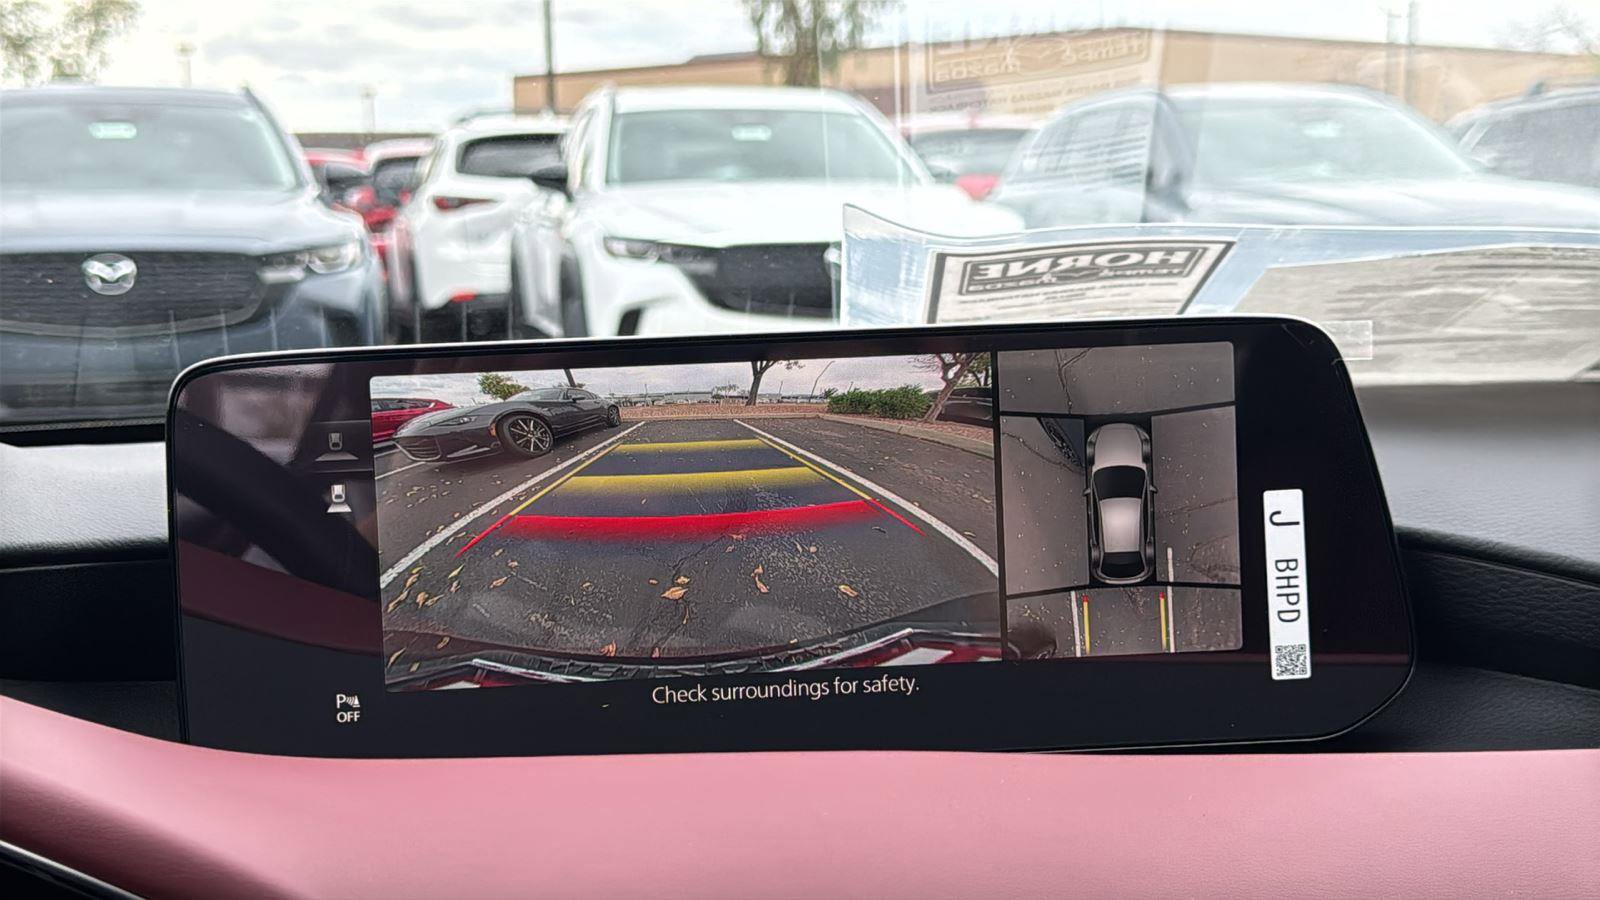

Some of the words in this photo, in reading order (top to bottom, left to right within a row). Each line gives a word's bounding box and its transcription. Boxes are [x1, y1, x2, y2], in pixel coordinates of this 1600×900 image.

[1269, 510, 1300, 527] J
[1274, 558, 1301, 623] BHPD
[652, 684, 708, 704] Check
[711, 678, 830, 700] surroundings
[833, 676, 859, 694] for
[862, 674, 920, 696] safety.
[336, 711, 360, 723] OFF
